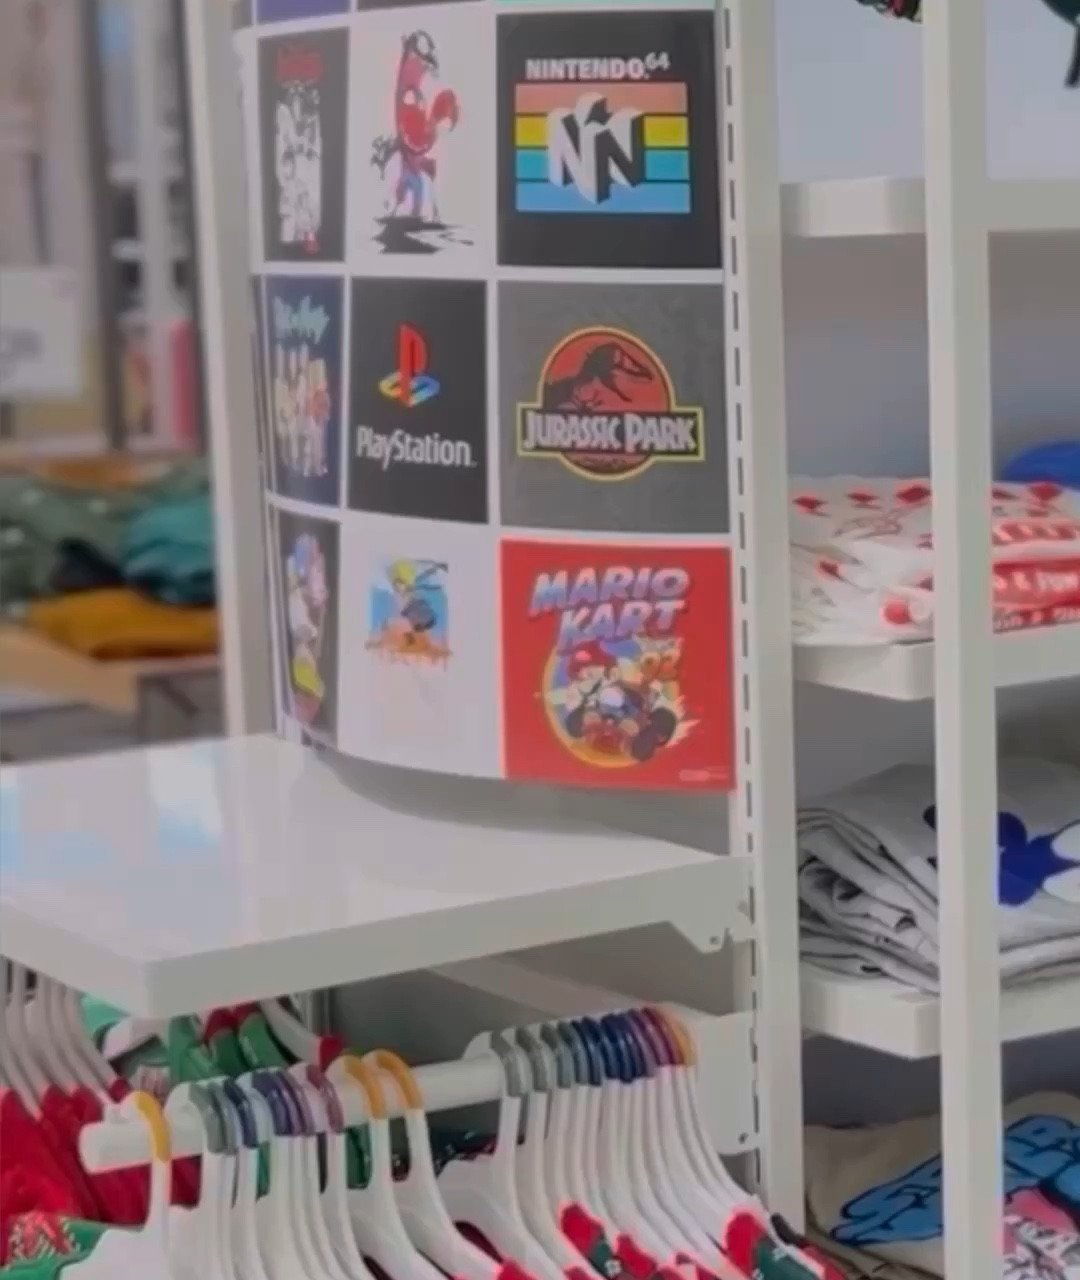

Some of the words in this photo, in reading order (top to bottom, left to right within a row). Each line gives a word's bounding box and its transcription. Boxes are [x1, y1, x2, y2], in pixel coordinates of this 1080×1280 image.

[524, 57, 644, 81] NINTENDO
[644, 51, 671, 71] 64
[356, 423, 473, 472] PlayStation
[523, 410, 622, 450] JURASSIC
[623, 411, 697, 454] PARK
[527, 565, 691, 618] MARIO
[557, 599, 687, 650] KART
